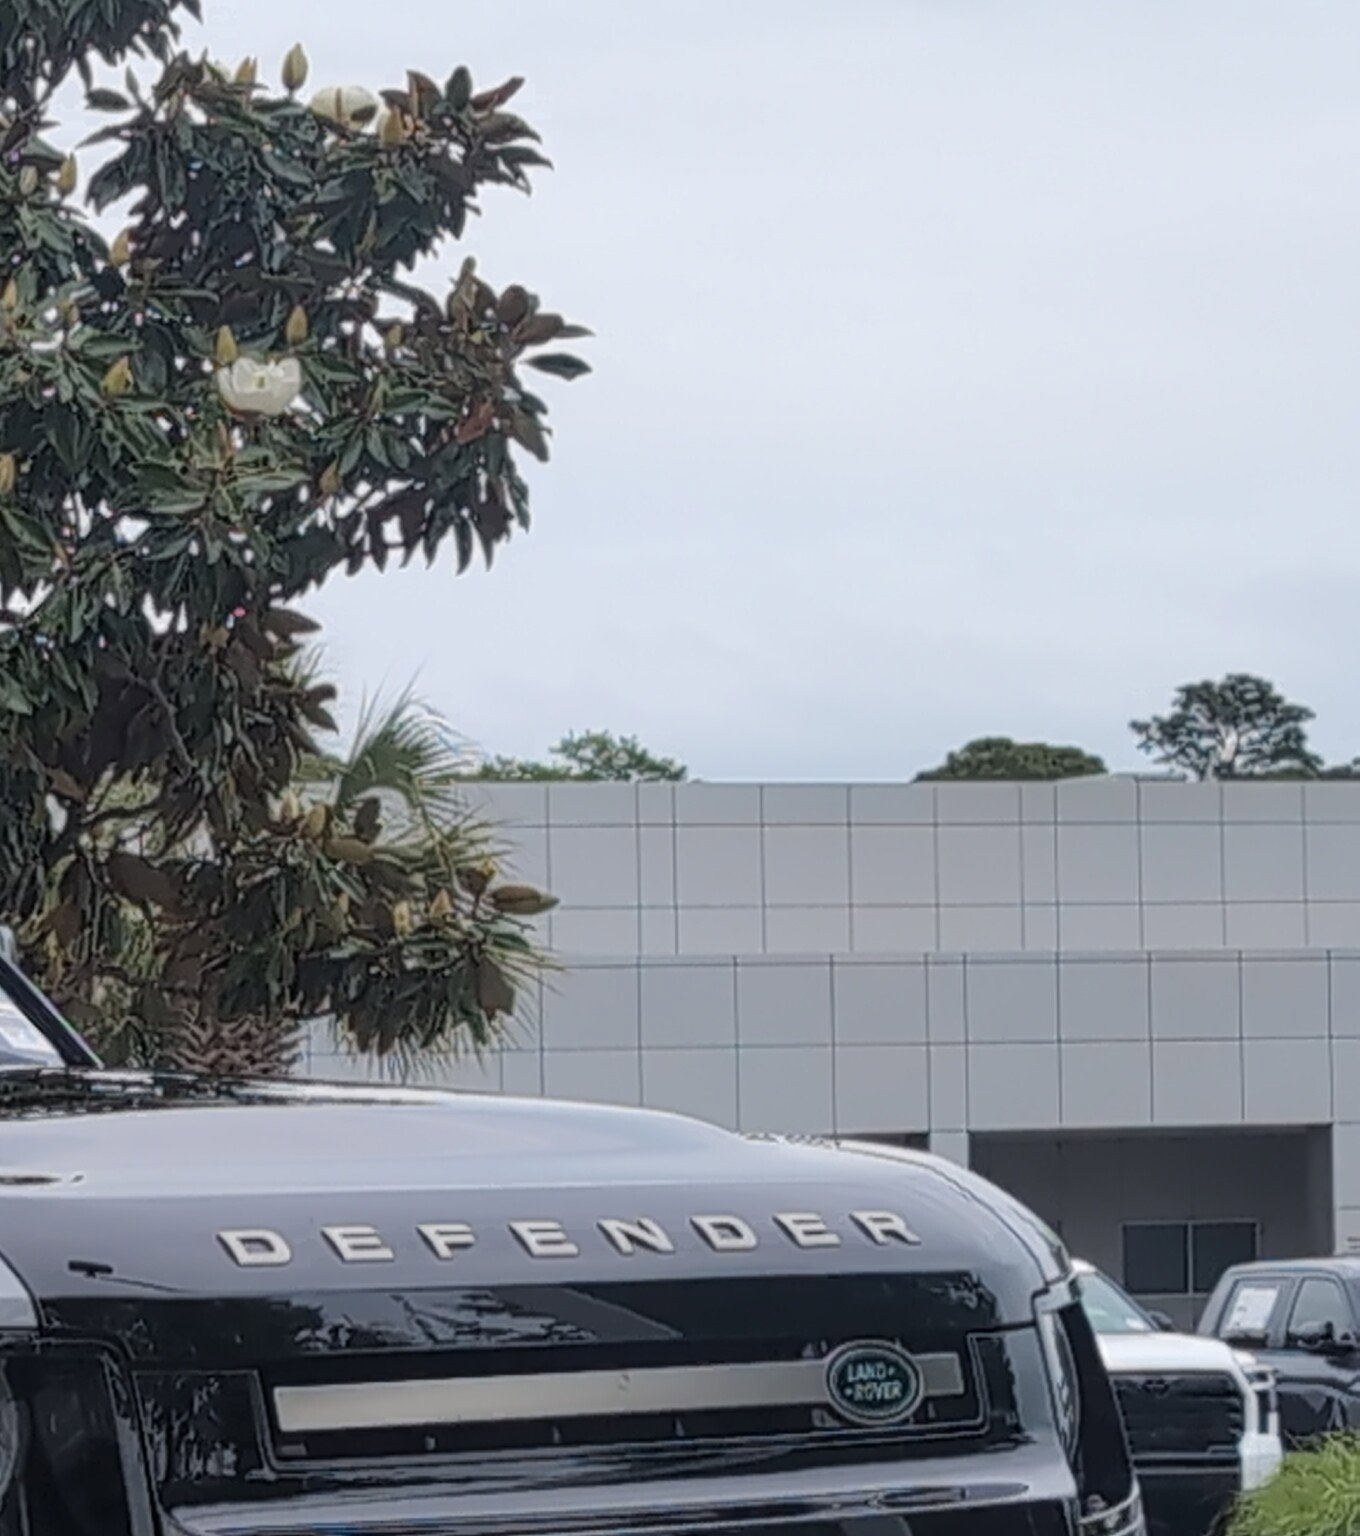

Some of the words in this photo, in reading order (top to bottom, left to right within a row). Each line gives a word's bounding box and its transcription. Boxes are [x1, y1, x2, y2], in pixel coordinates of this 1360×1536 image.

[216, 1209, 921, 1267] DEFENDER
[847, 1362, 886, 1382] LAND
[853, 1381, 903, 1401] ROVER
